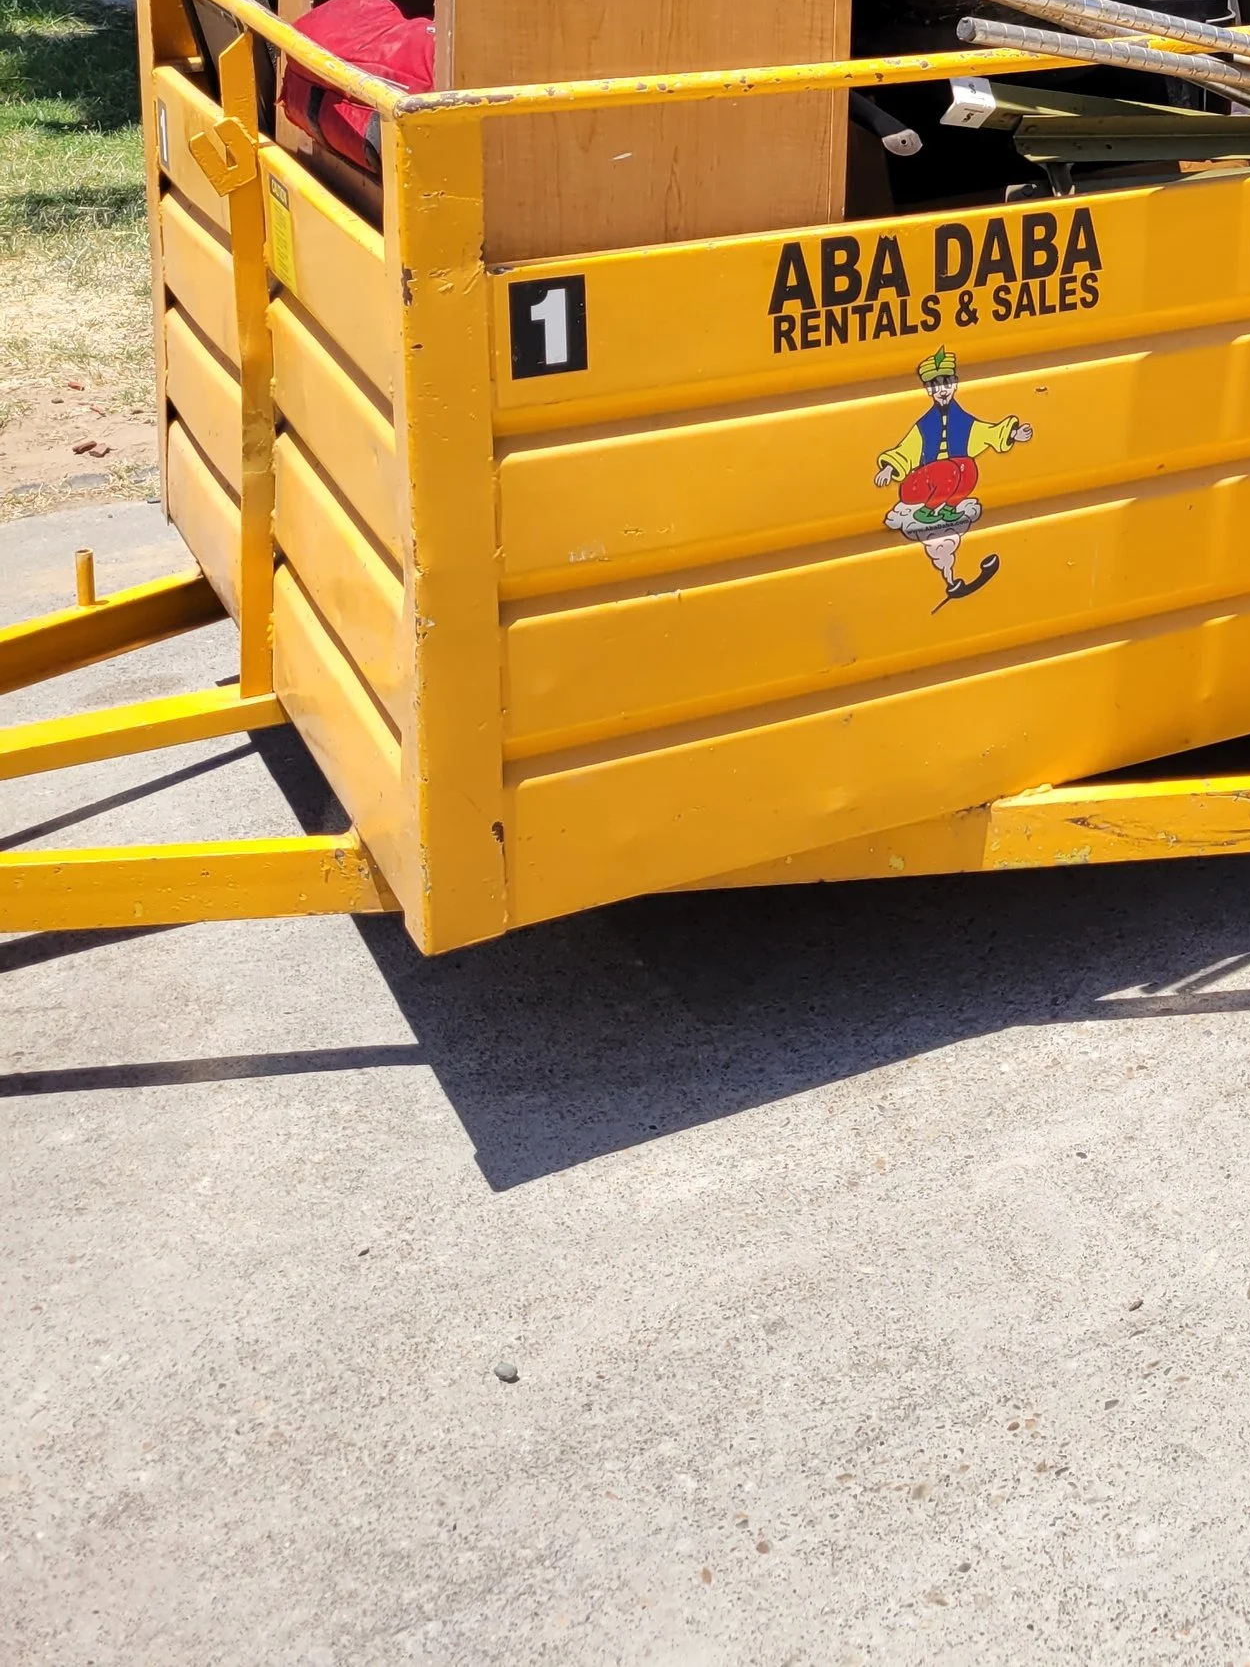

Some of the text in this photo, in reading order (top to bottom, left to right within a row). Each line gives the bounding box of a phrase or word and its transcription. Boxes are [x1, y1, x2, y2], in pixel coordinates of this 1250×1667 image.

[768, 207, 1103, 315] ABA DABA
[530, 288, 568, 366] 1
[773, 272, 1100, 354] RENTALS & SALES
